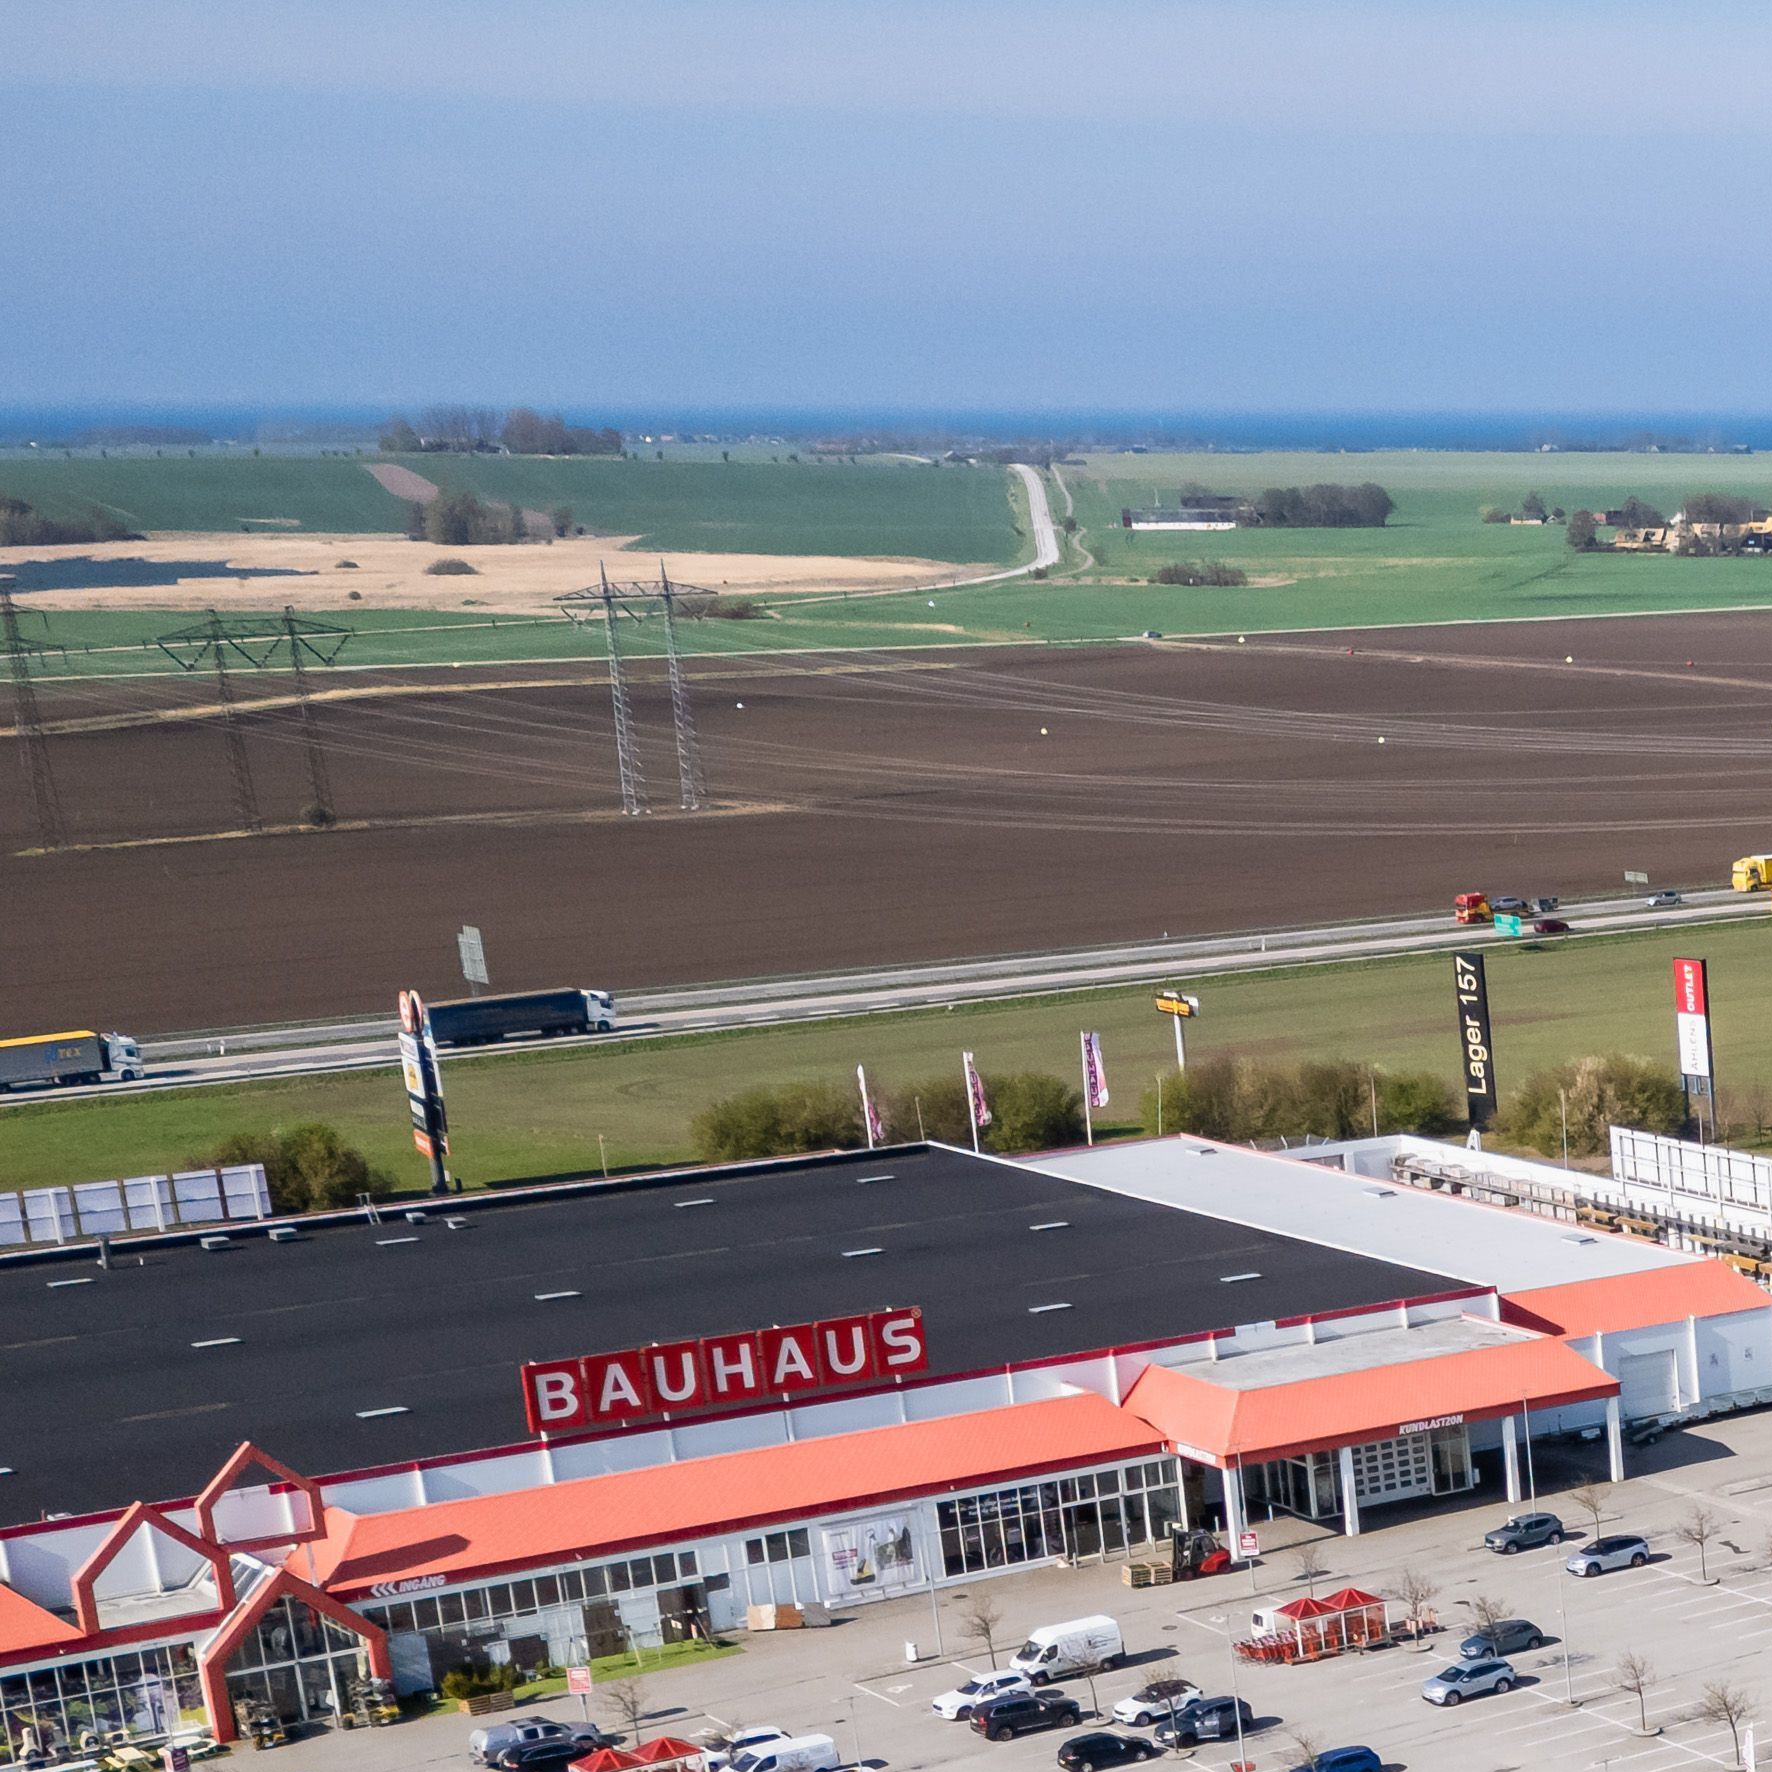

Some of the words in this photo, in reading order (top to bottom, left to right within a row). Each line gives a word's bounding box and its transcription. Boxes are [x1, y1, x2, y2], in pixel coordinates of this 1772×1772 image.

[1456, 957, 1478, 1005] 157
[1683, 964, 1695, 1012] OUTLET
[1466, 1015, 1488, 1094] Lager
[534, 1317, 921, 1421] BAUHAUS
[1399, 1414, 1464, 1435] KUNDLASTZON
[399, 1574, 447, 1592] INGÅNG
